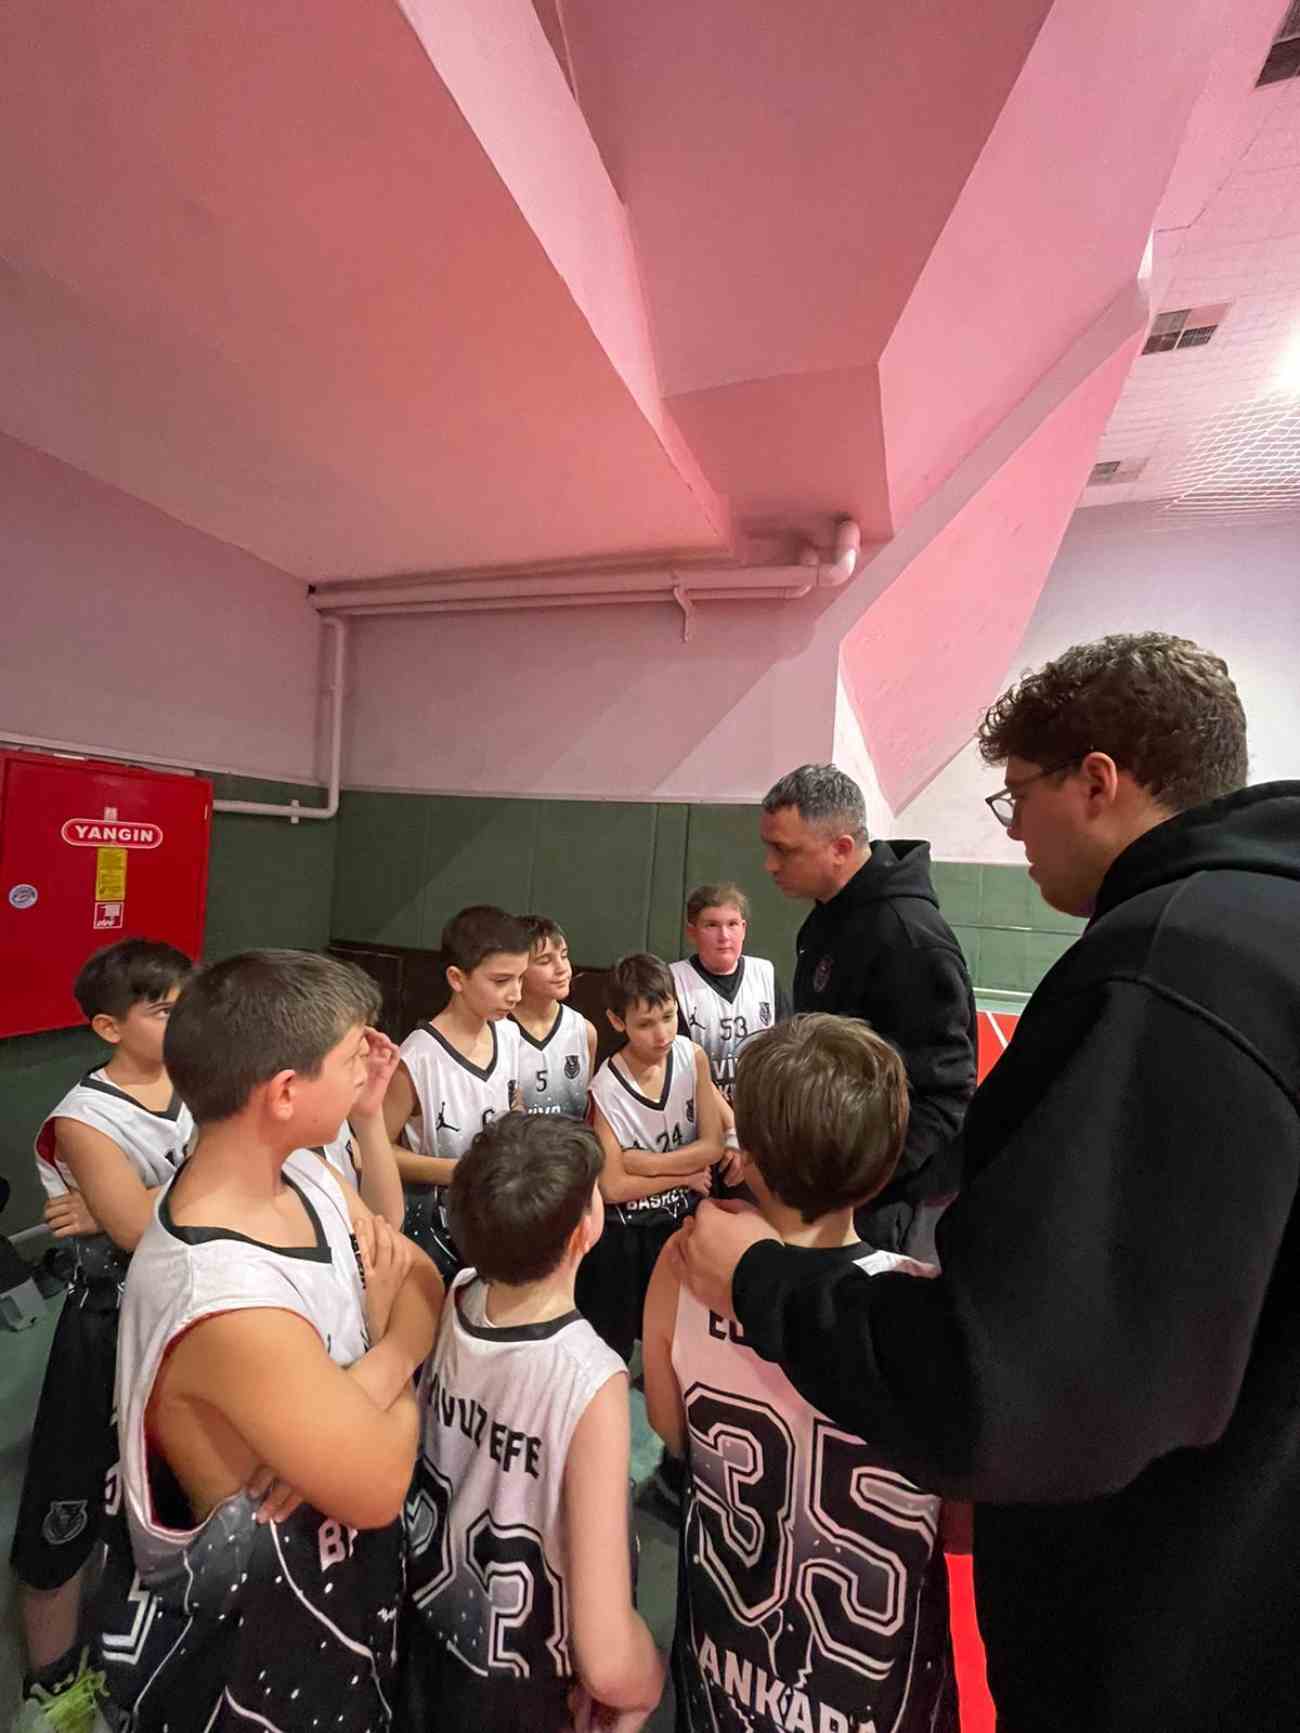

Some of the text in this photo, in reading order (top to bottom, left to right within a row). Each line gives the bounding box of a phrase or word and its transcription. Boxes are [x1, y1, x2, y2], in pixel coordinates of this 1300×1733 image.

[75, 825, 154, 842] YANGIN
[720, 1016, 748, 1040] 53
[536, 1070, 548, 1092] 5
[656, 1124, 683, 1152] 24
[490, 1421, 542, 1479] EFE
[684, 1382, 937, 1681] 35
